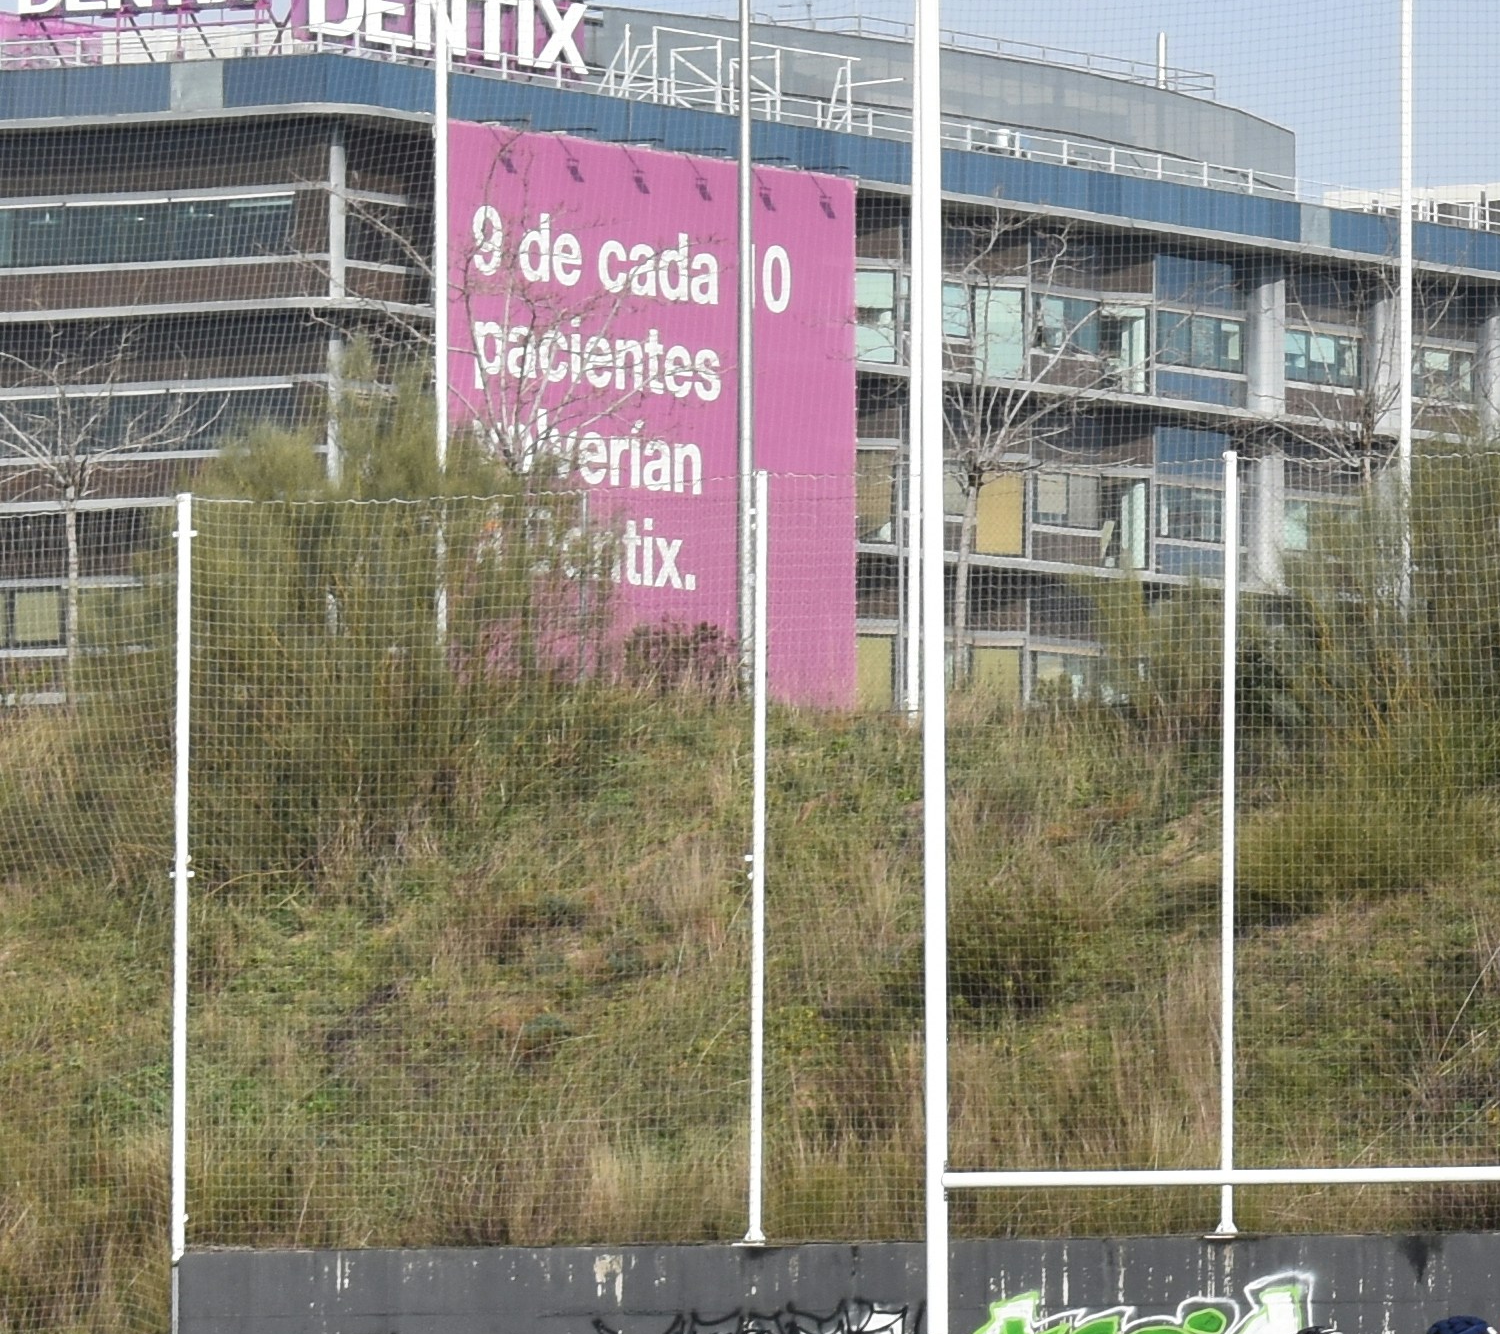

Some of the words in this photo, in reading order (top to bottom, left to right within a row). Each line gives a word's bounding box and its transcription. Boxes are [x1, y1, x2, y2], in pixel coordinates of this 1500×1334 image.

[472, 205, 502, 275] 9
[518, 213, 582, 286] de
[598, 233, 718, 305] cada
[474, 317, 721, 401] pacientes
